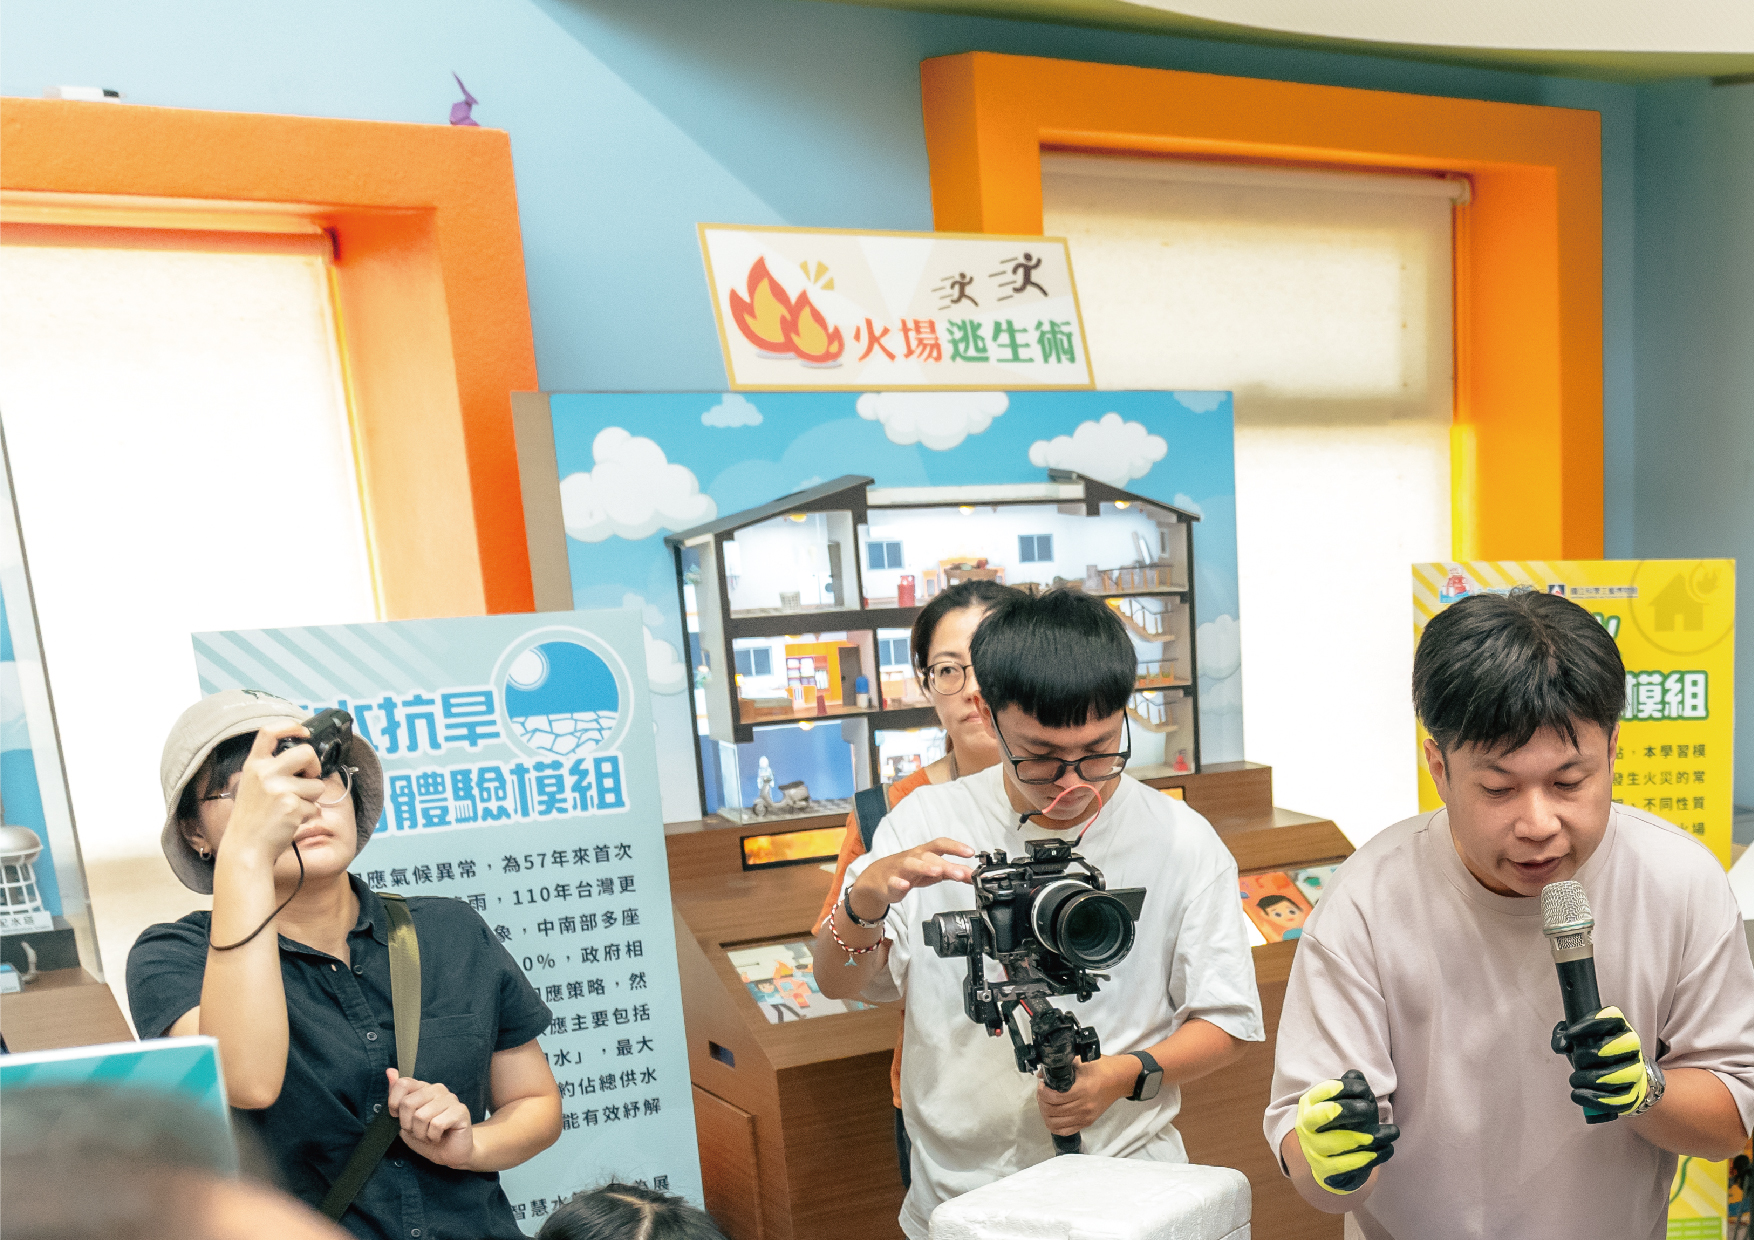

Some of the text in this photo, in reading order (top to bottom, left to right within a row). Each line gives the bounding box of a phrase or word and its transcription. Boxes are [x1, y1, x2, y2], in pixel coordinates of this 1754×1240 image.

[853, 317, 1077, 363] 火場逃生術
[372, 755, 626, 834] 體驗模組
[458, 875, 636, 912] 雨，110年台灣更
[541, 1004, 650, 1036] 應主要包括
[545, 1036, 654, 1067] 水」，最大
[559, 1067, 658, 1099] 約佔總供水
[563, 1097, 662, 1130] 能有效紓解
